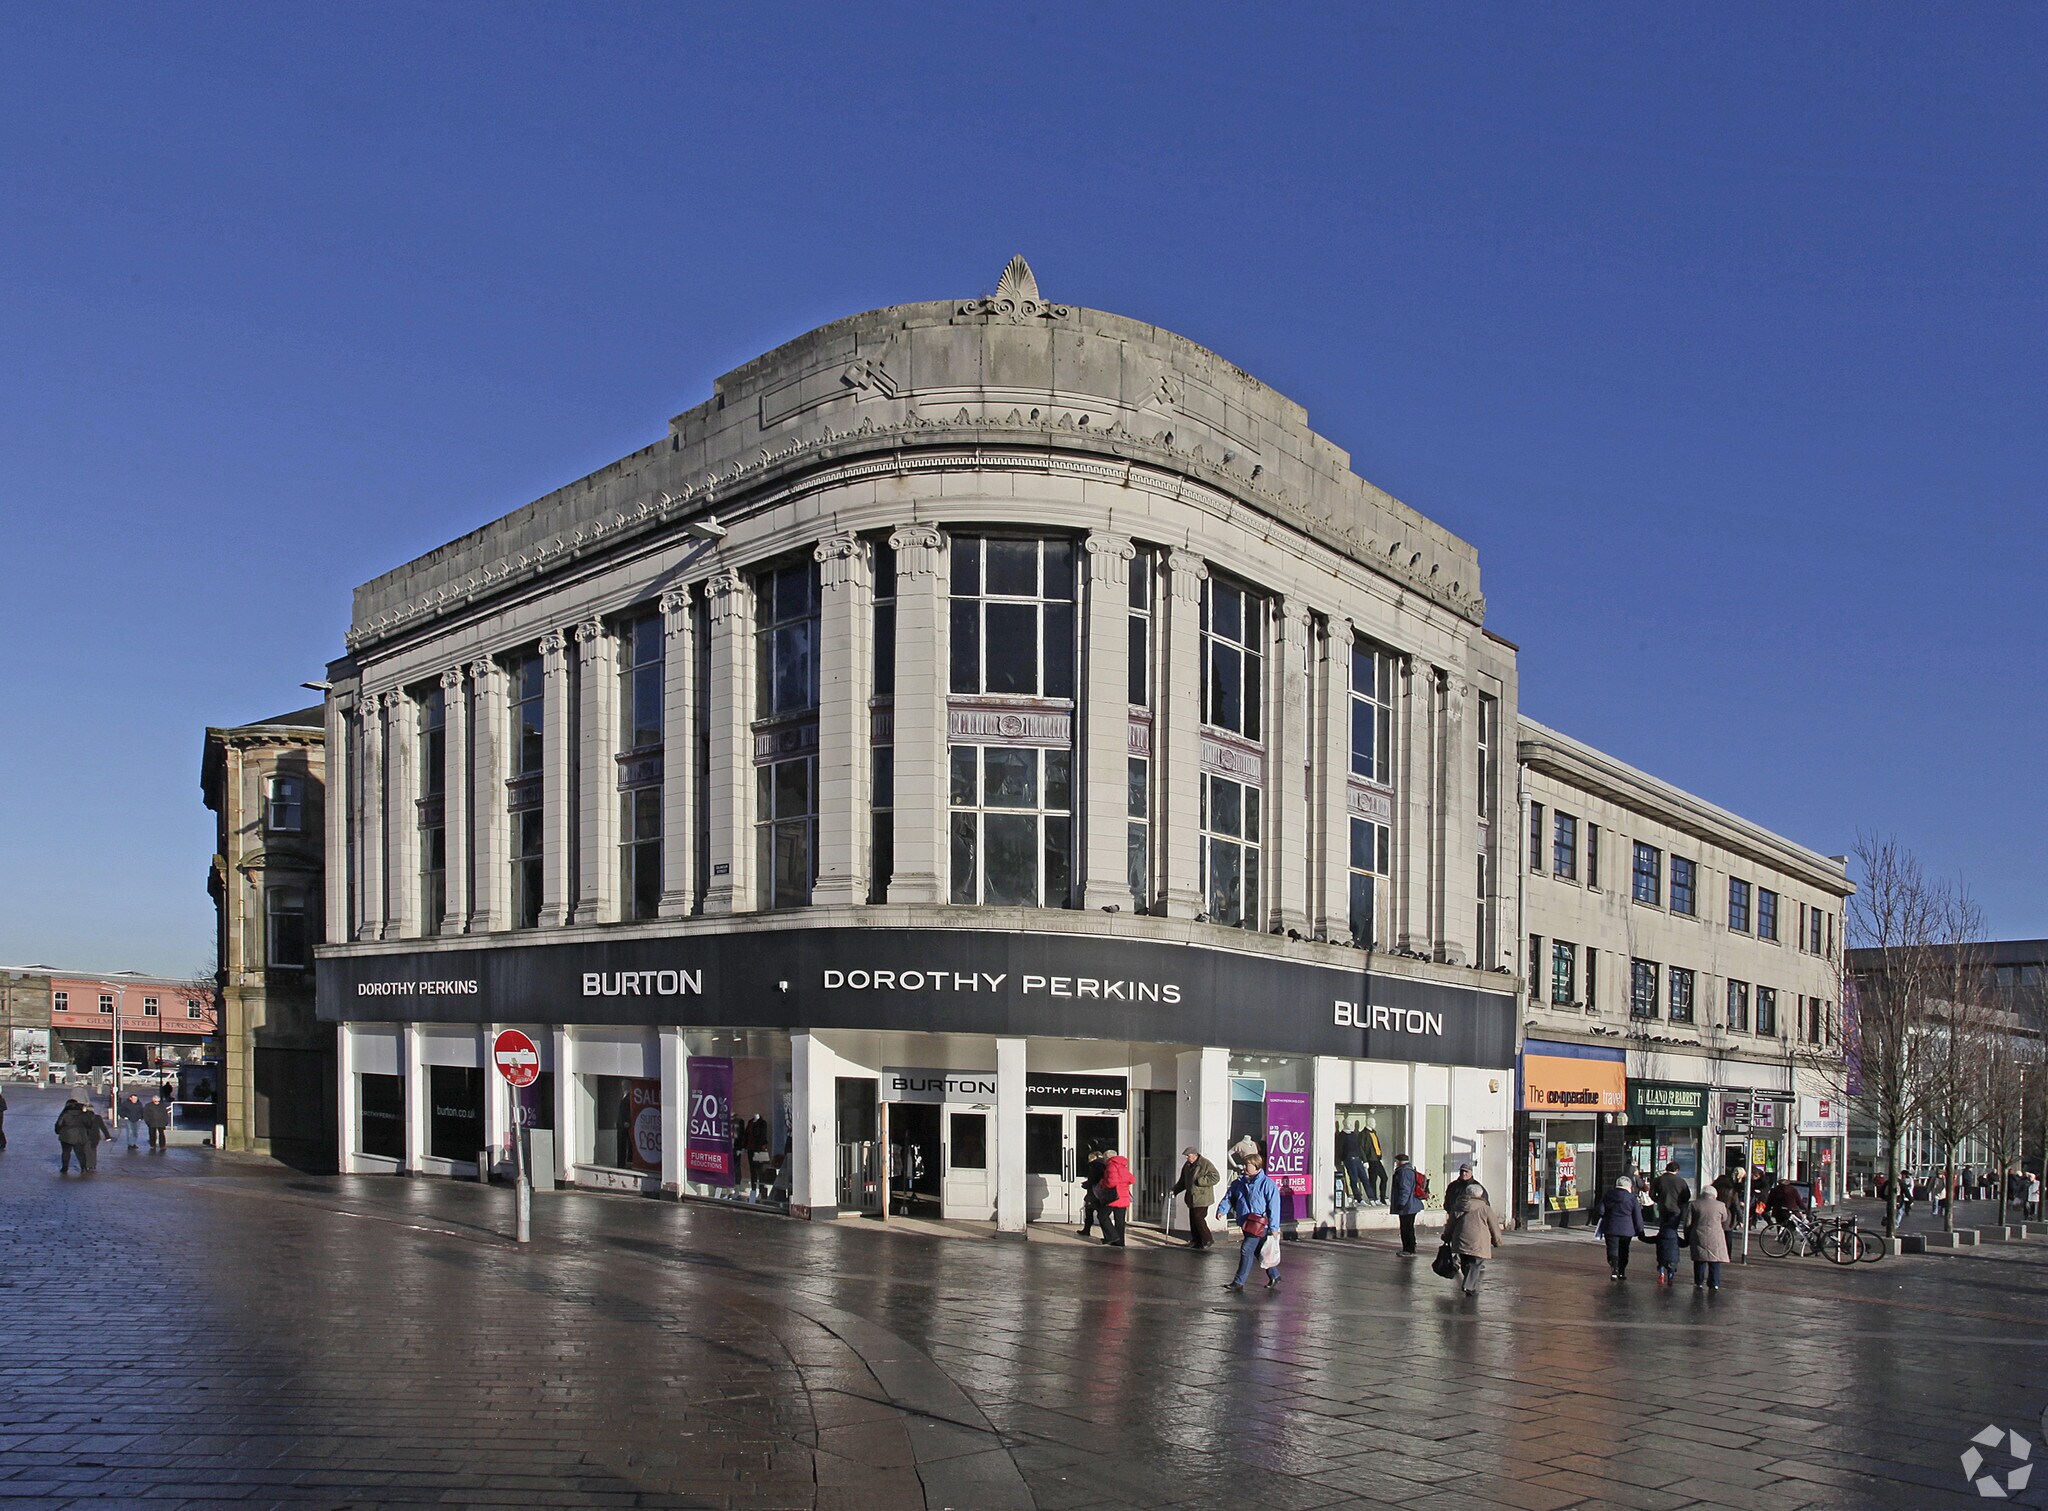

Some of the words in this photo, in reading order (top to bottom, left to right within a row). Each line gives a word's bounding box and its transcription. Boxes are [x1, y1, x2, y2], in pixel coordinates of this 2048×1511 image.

[357, 981, 416, 996] DOROTHY
[418, 979, 478, 995] PERKINS
[582, 969, 702, 996] BURTON
[823, 969, 1007, 993] DOROTHY
[1021, 974, 1181, 1004] PERKINS
[131, 1019, 159, 1027] STREE
[1333, 1000, 1443, 1036] BURTON
[892, 1078, 996, 1094] BURTON
[1026, 1086, 1069, 1094] ROTHY
[1071, 1087, 1122, 1096] PERKINS
[1529, 1085, 1544, 1103] The
[1602, 1089, 1623, 1105] travel
[691, 1094, 729, 1119] 70%
[690, 1119, 729, 1138] SALE
[1269, 1130, 1306, 1154] 70%
[690, 1159, 723, 1170] REDUCTIONS
[691, 1152, 722, 1163] FURTHER
[1268, 1155, 1304, 1172] SALE
[1559, 1166, 1574, 1177] SALE
